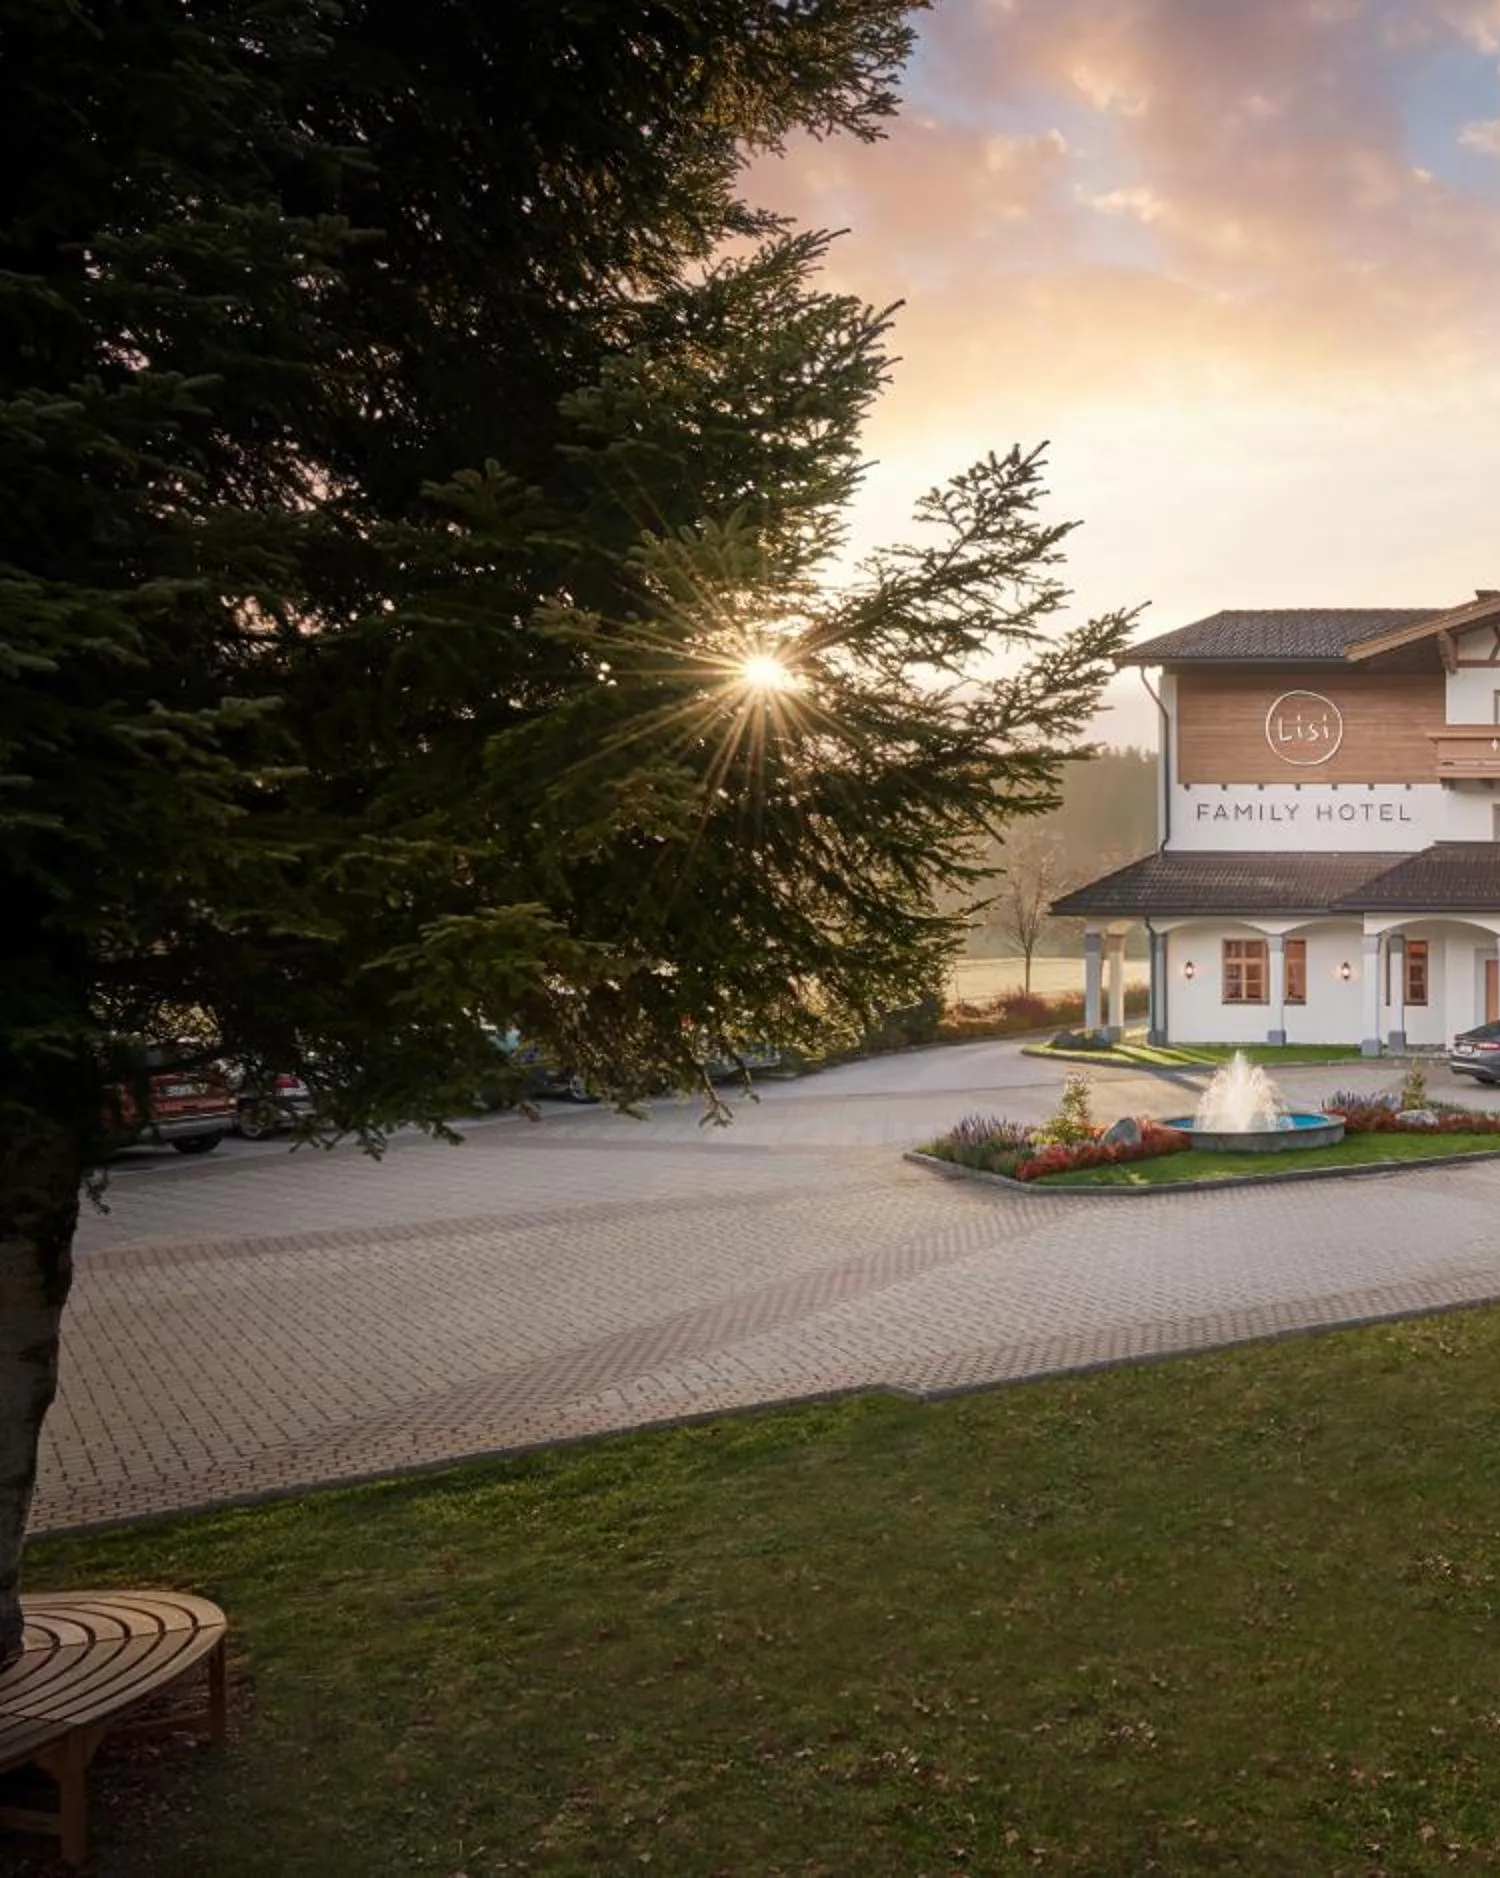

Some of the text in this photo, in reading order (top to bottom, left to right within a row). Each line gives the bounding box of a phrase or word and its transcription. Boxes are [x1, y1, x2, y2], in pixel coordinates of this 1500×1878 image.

[1278, 714, 1329, 741] Lisi
[1196, 803, 1412, 821] FAMILY HOTEL
